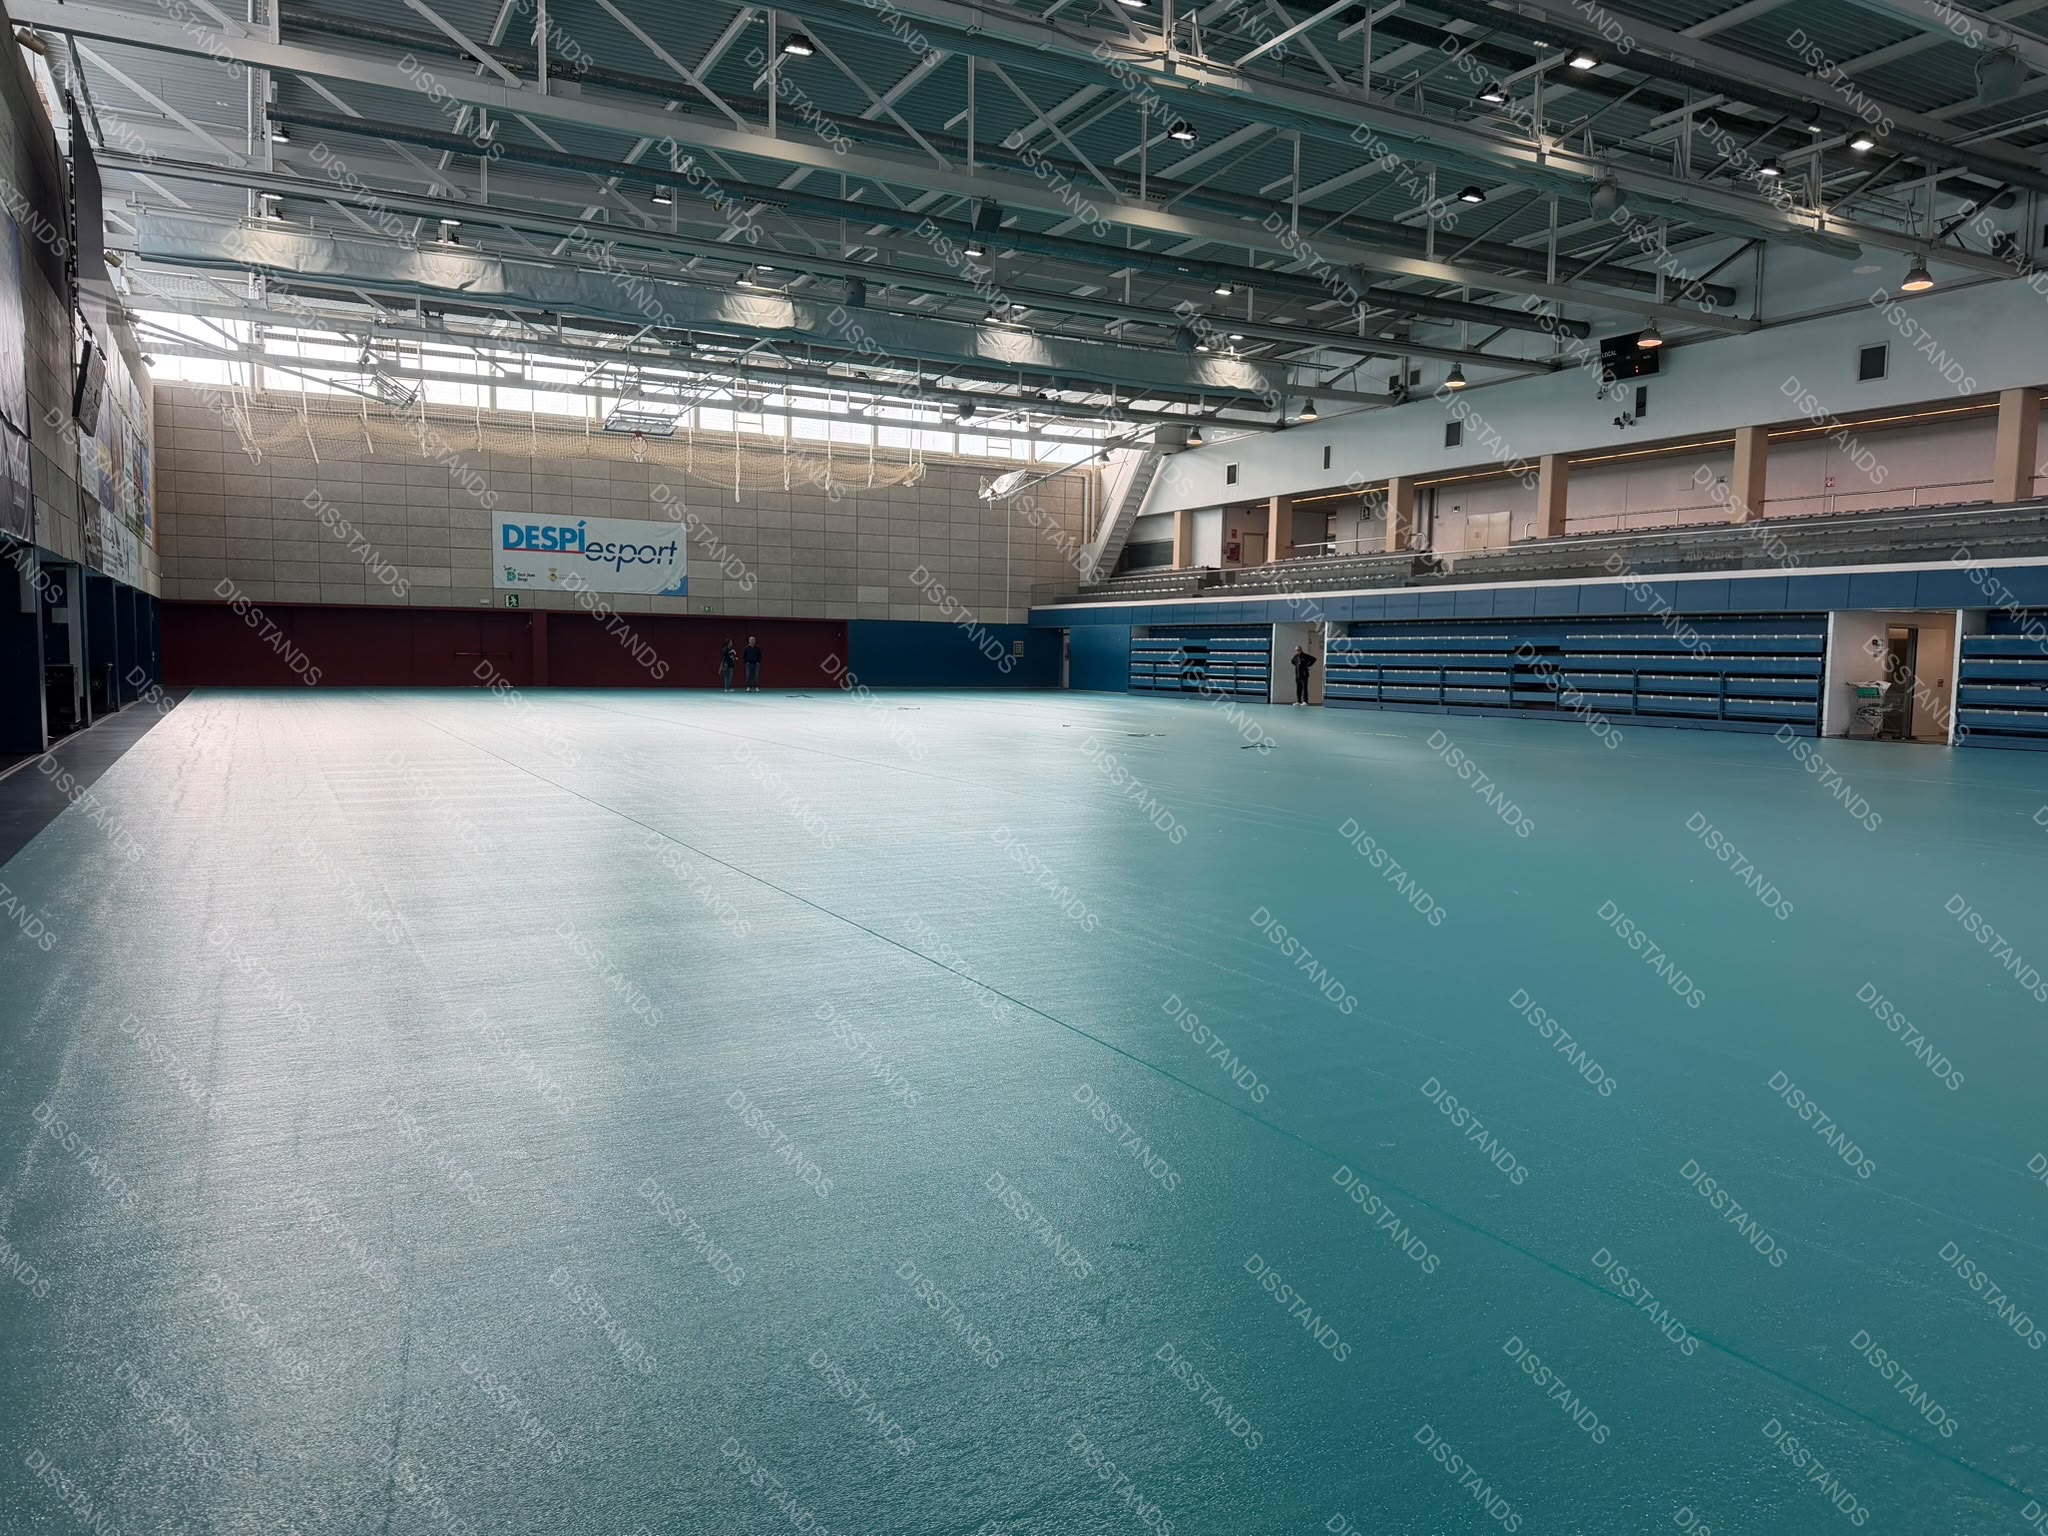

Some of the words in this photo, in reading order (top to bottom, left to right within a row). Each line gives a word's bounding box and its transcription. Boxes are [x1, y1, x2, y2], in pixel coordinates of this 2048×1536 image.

[1601, 350, 1616, 358] LOCAL
[502, 520, 587, 552] DESPÍ
[585, 540, 678, 573] esport
